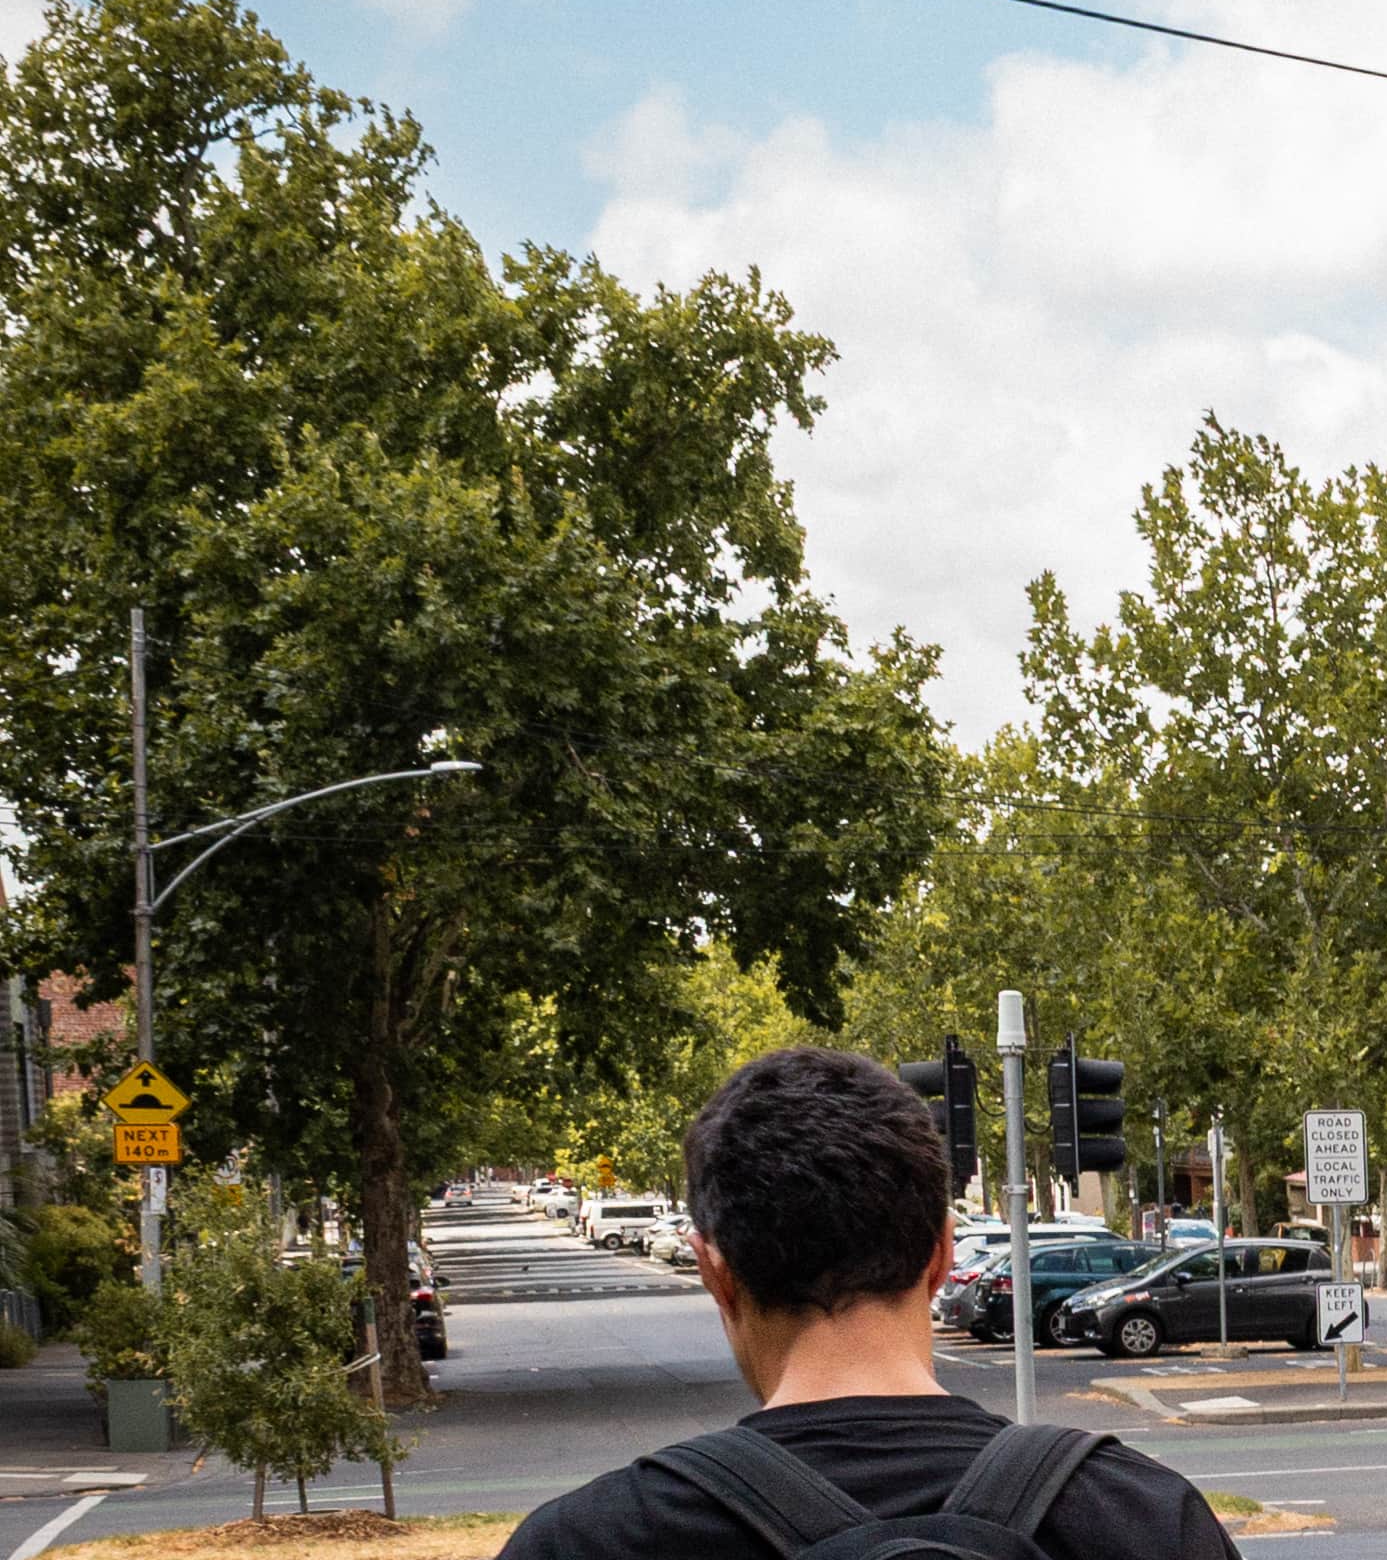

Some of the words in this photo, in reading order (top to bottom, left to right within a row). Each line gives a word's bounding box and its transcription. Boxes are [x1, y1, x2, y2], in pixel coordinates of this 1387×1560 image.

[1318, 1118, 1352, 1127] ROAD
[124, 1130, 169, 1141] NEXT
[1311, 1131, 1359, 1141] CLOSED
[1315, 1144, 1357, 1153] AHEAD
[1316, 1162, 1357, 1172] LOCAL
[1313, 1175, 1361, 1185] TRAFFIC
[1321, 1188, 1353, 1198] ONLY
[1326, 1288, 1355, 1298] KEEP
[1327, 1301, 1353, 1311] LEFT
